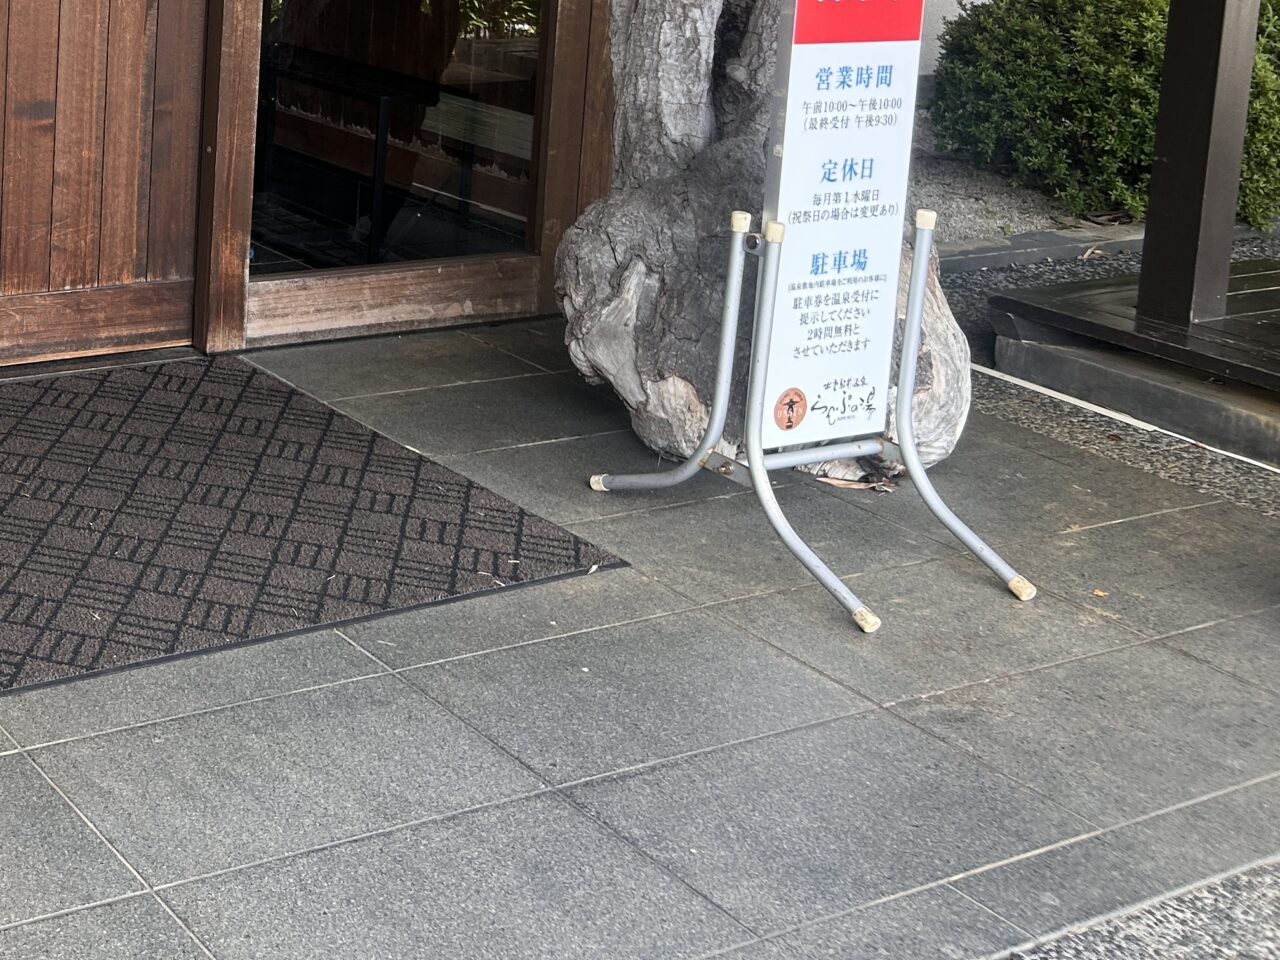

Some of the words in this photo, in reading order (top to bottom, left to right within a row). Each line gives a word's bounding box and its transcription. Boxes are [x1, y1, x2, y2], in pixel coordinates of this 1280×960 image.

[815, 63, 894, 91] 営業時間
[820, 157, 874, 184] 定休日
[809, 248, 869, 276] 駐車場
[792, 289, 880, 310] 駐車券を温泉受付に
[799, 307, 871, 326] 提示してください
[806, 322, 861, 341] 2時間無料と
[792, 337, 871, 359] させていただきます
